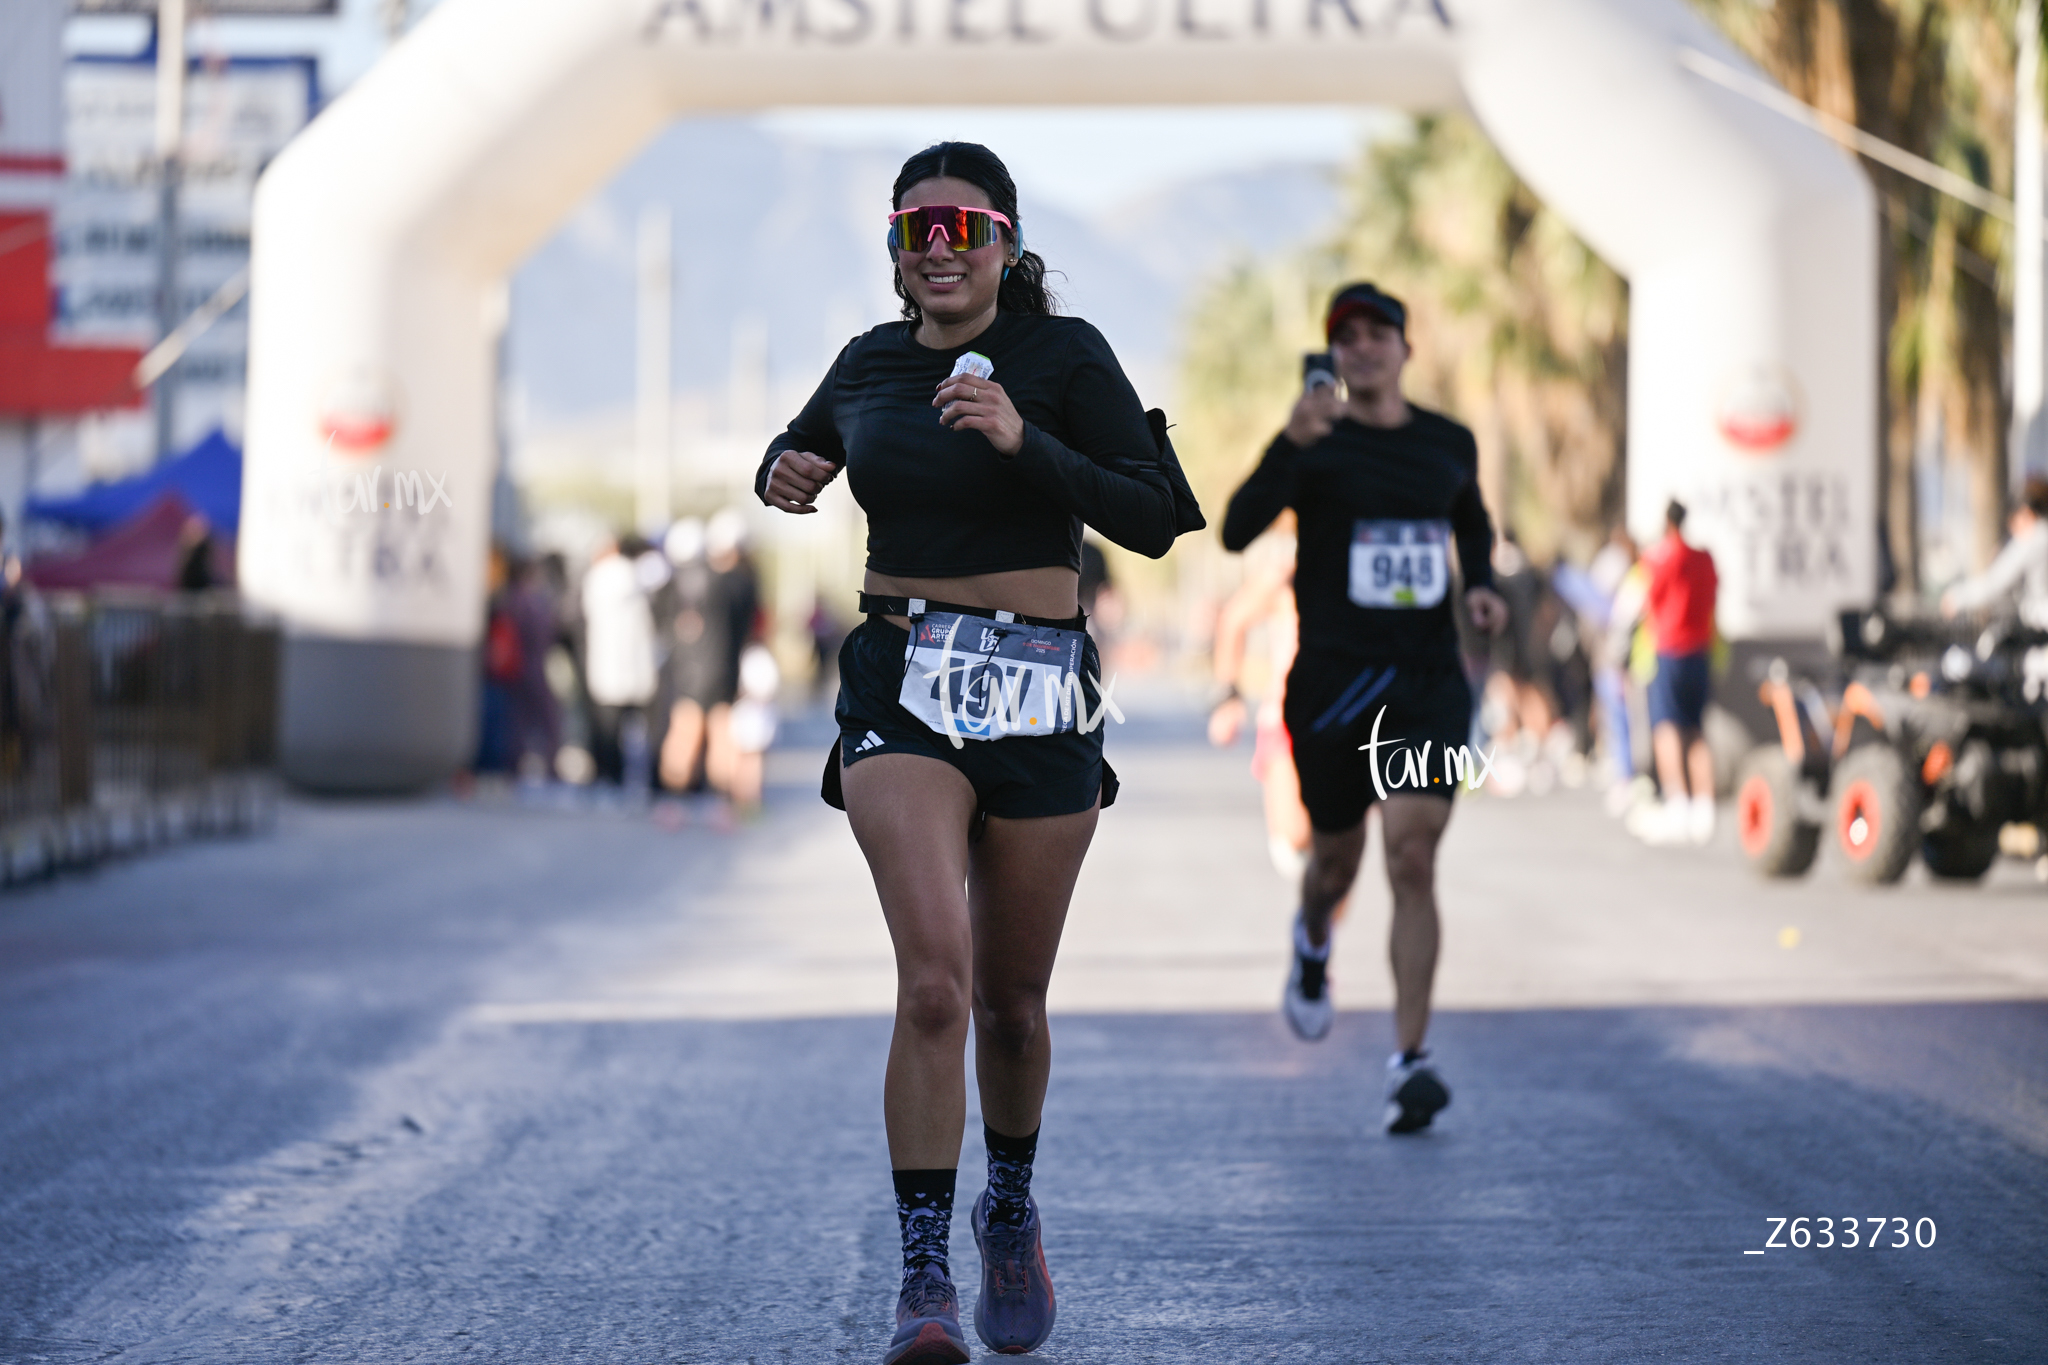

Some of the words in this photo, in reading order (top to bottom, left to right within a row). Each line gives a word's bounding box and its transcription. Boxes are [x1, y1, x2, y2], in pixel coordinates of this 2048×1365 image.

[1373, 554, 1433, 588] 948
[930, 633, 954, 641] ARTEC
[930, 657, 1033, 723] 497
